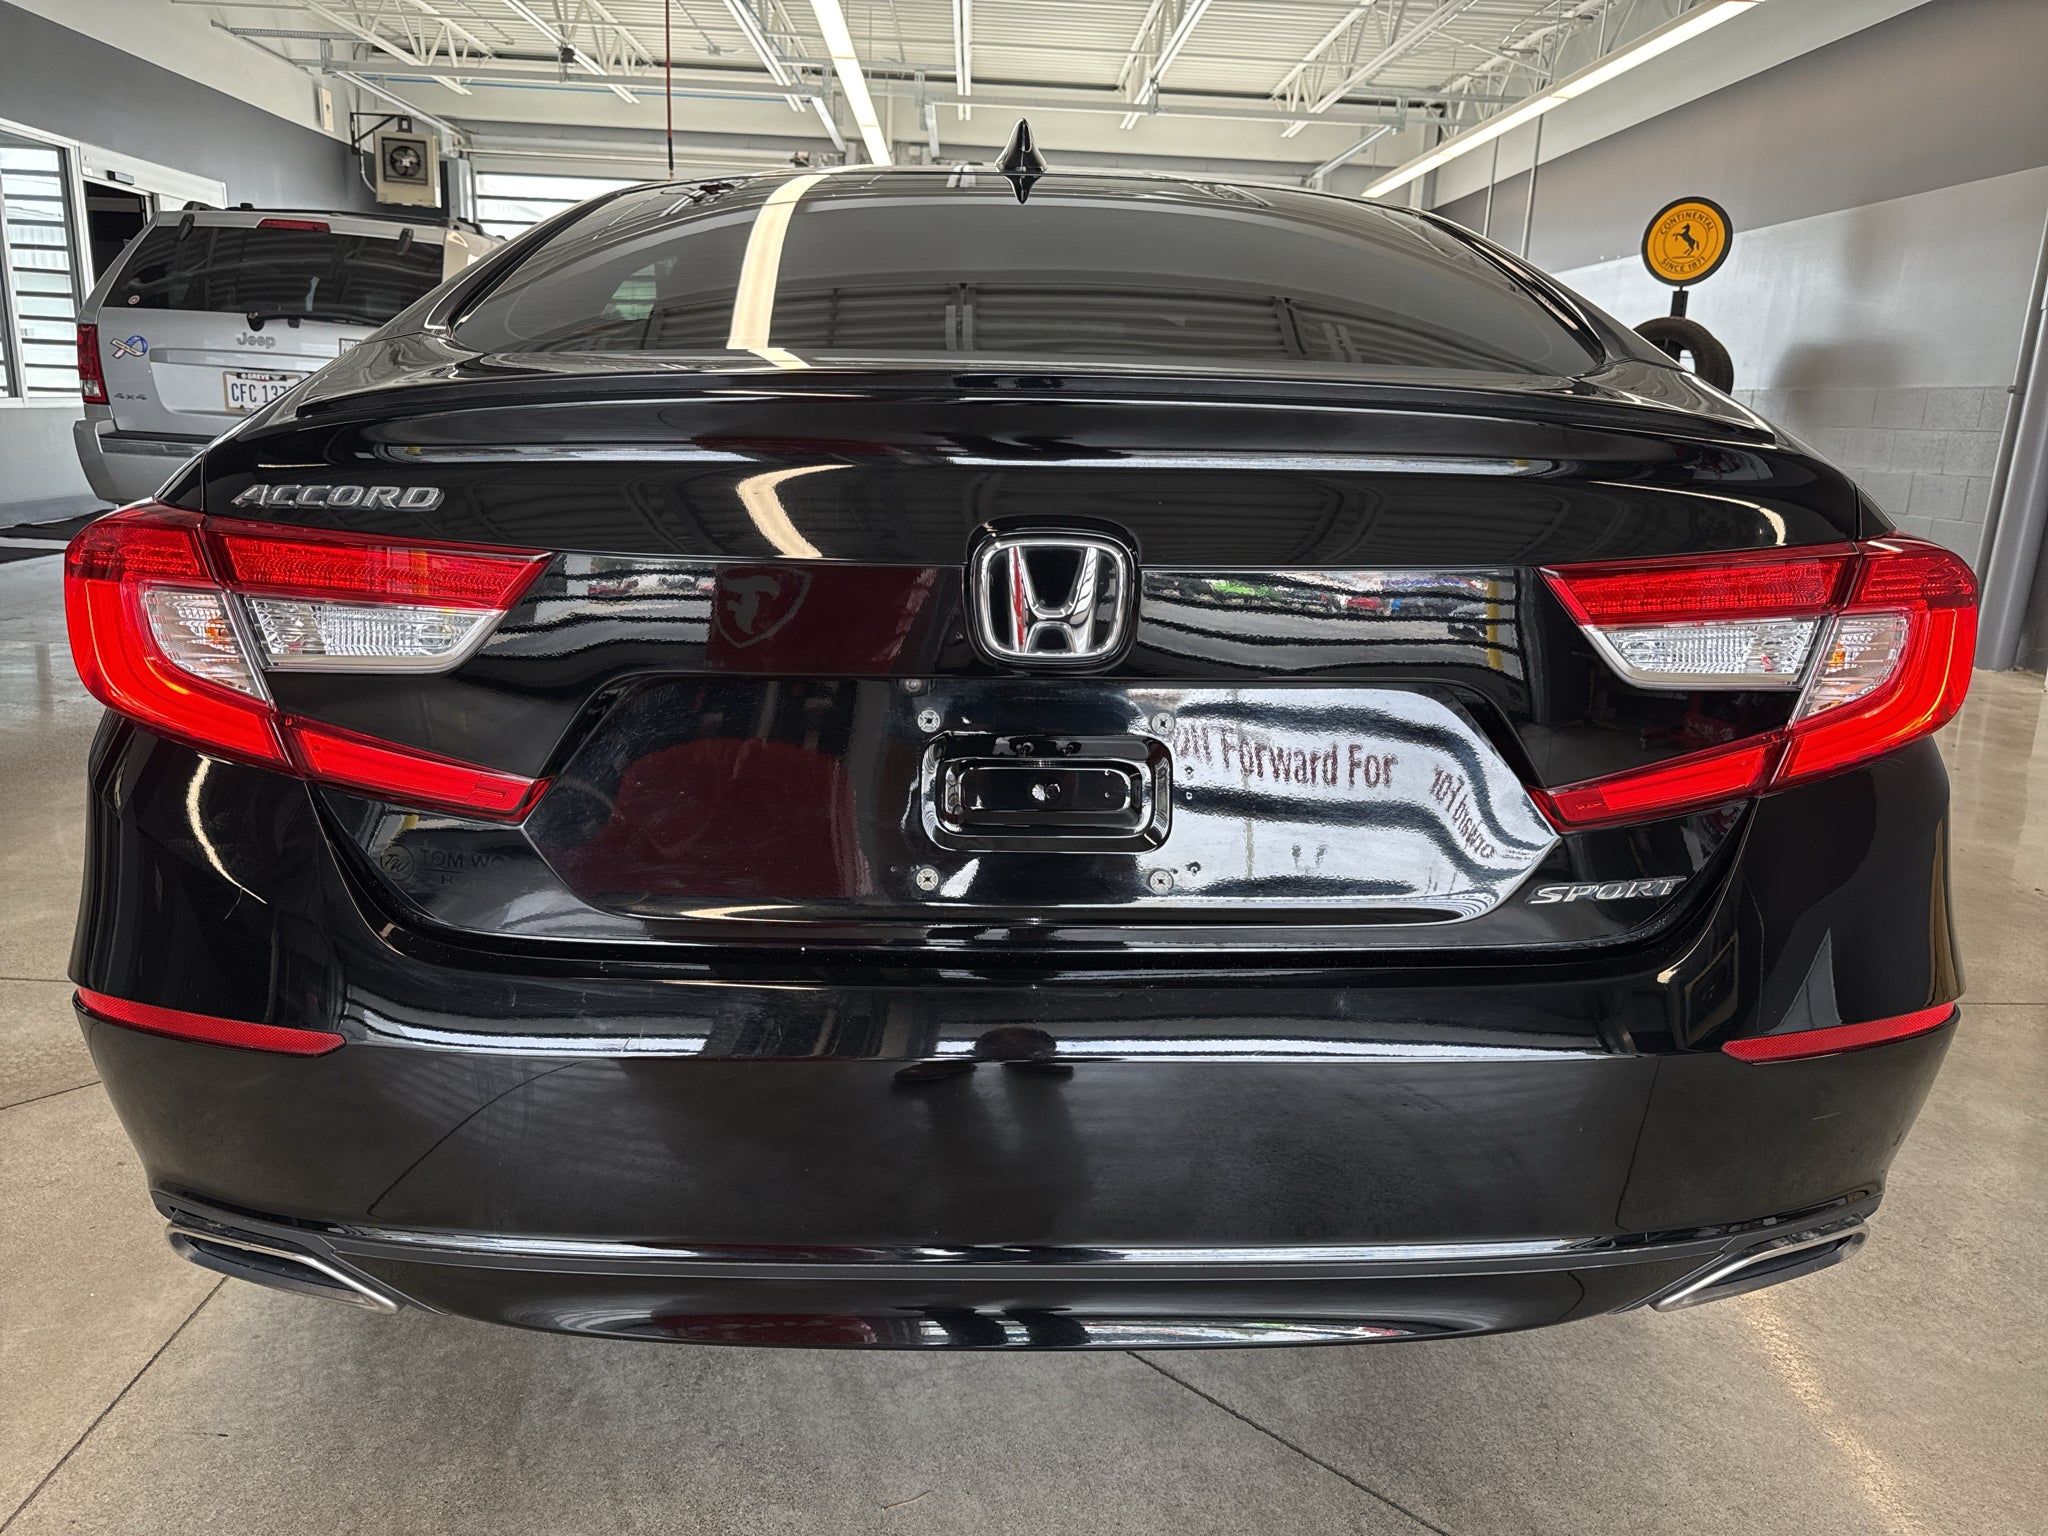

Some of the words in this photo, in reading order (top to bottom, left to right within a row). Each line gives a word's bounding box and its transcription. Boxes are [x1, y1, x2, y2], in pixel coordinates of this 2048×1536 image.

[1660, 211, 1714, 235] CONTINENTAL
[1661, 258, 1685, 272] SINCE
[1688, 256, 1706, 270] 1871
[236, 332, 277, 349] Jeep
[231, 383, 257, 403] CFC
[230, 484, 445, 512] ACCORD
[1219, 725, 1338, 787] Forward
[1348, 742, 1398, 789] For
[420, 849, 464, 869] TOM
[1526, 876, 1687, 904] SPORT
